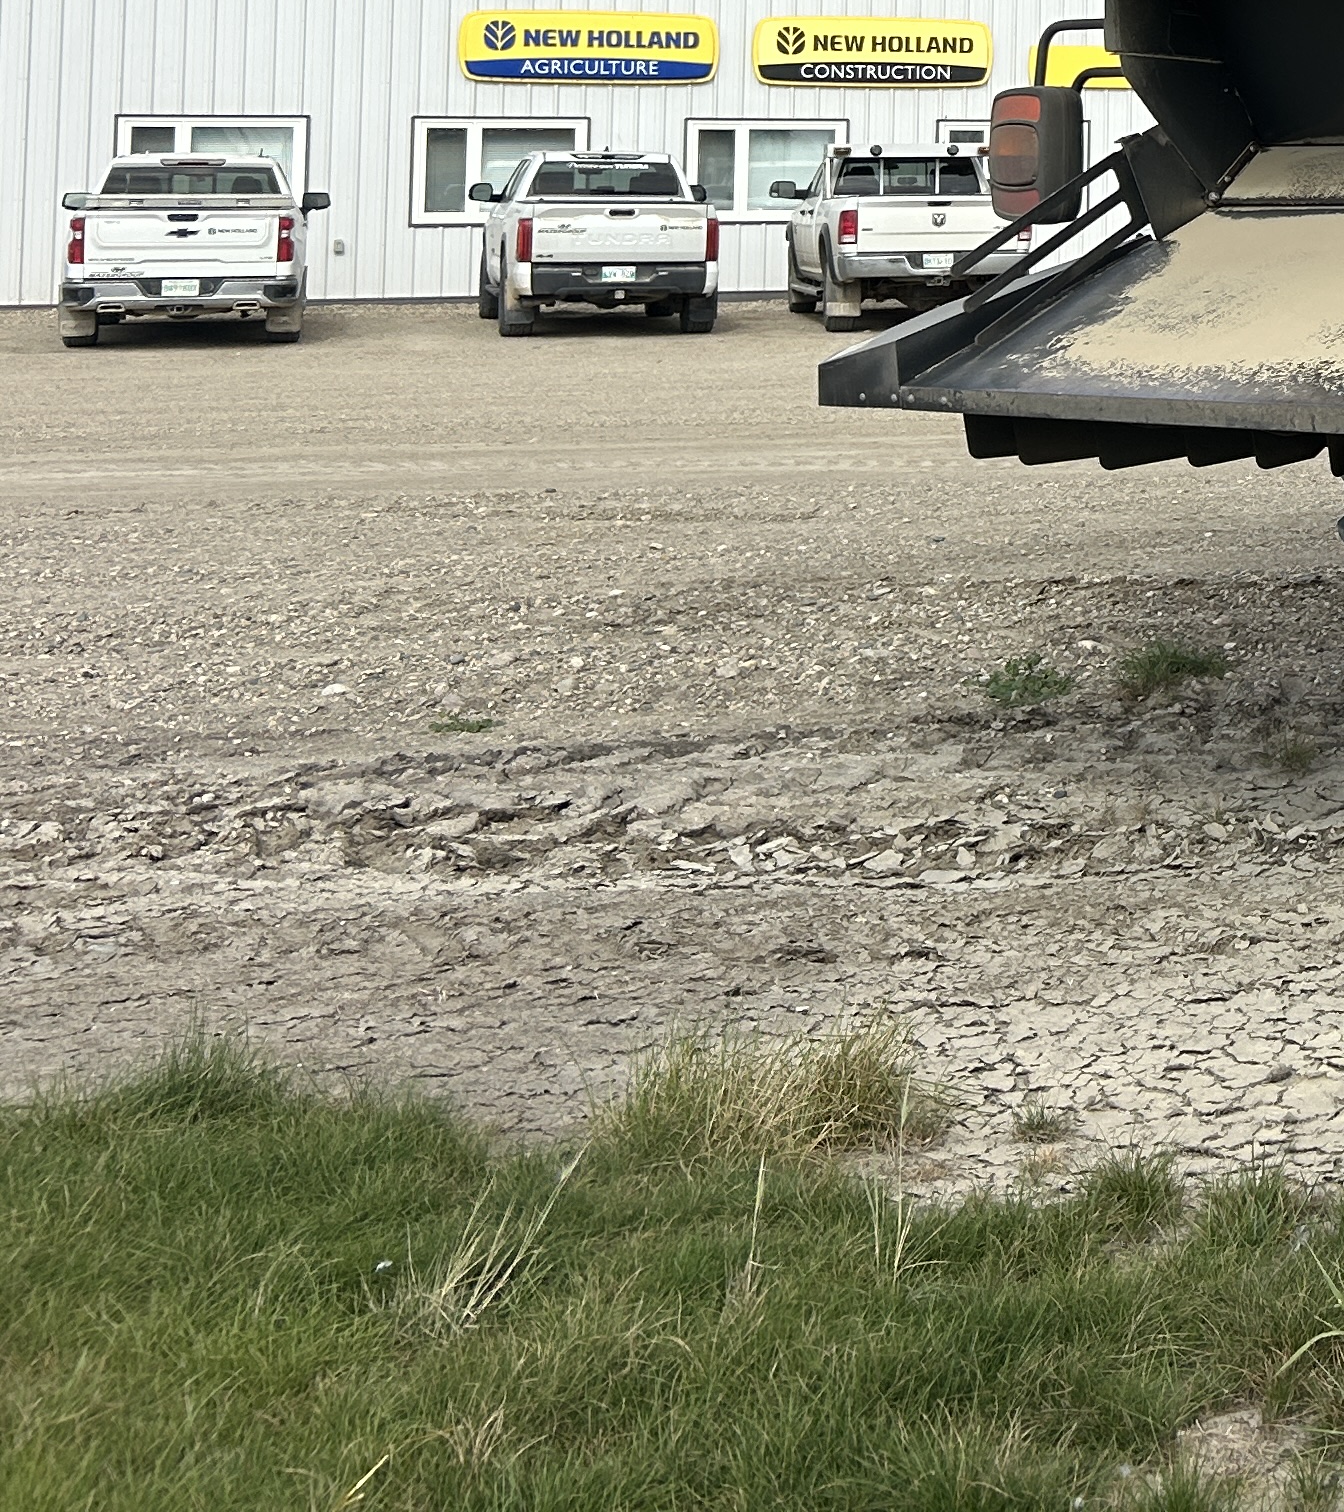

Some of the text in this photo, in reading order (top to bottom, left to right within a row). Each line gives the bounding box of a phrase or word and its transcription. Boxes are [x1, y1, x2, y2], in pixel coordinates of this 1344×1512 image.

[523, 28, 700, 50] NEW HOLLAND
[813, 34, 974, 54] NEW HOLLAND
[520, 59, 660, 76] AGRICULTURE
[800, 63, 952, 81] CONSTRUCTION
